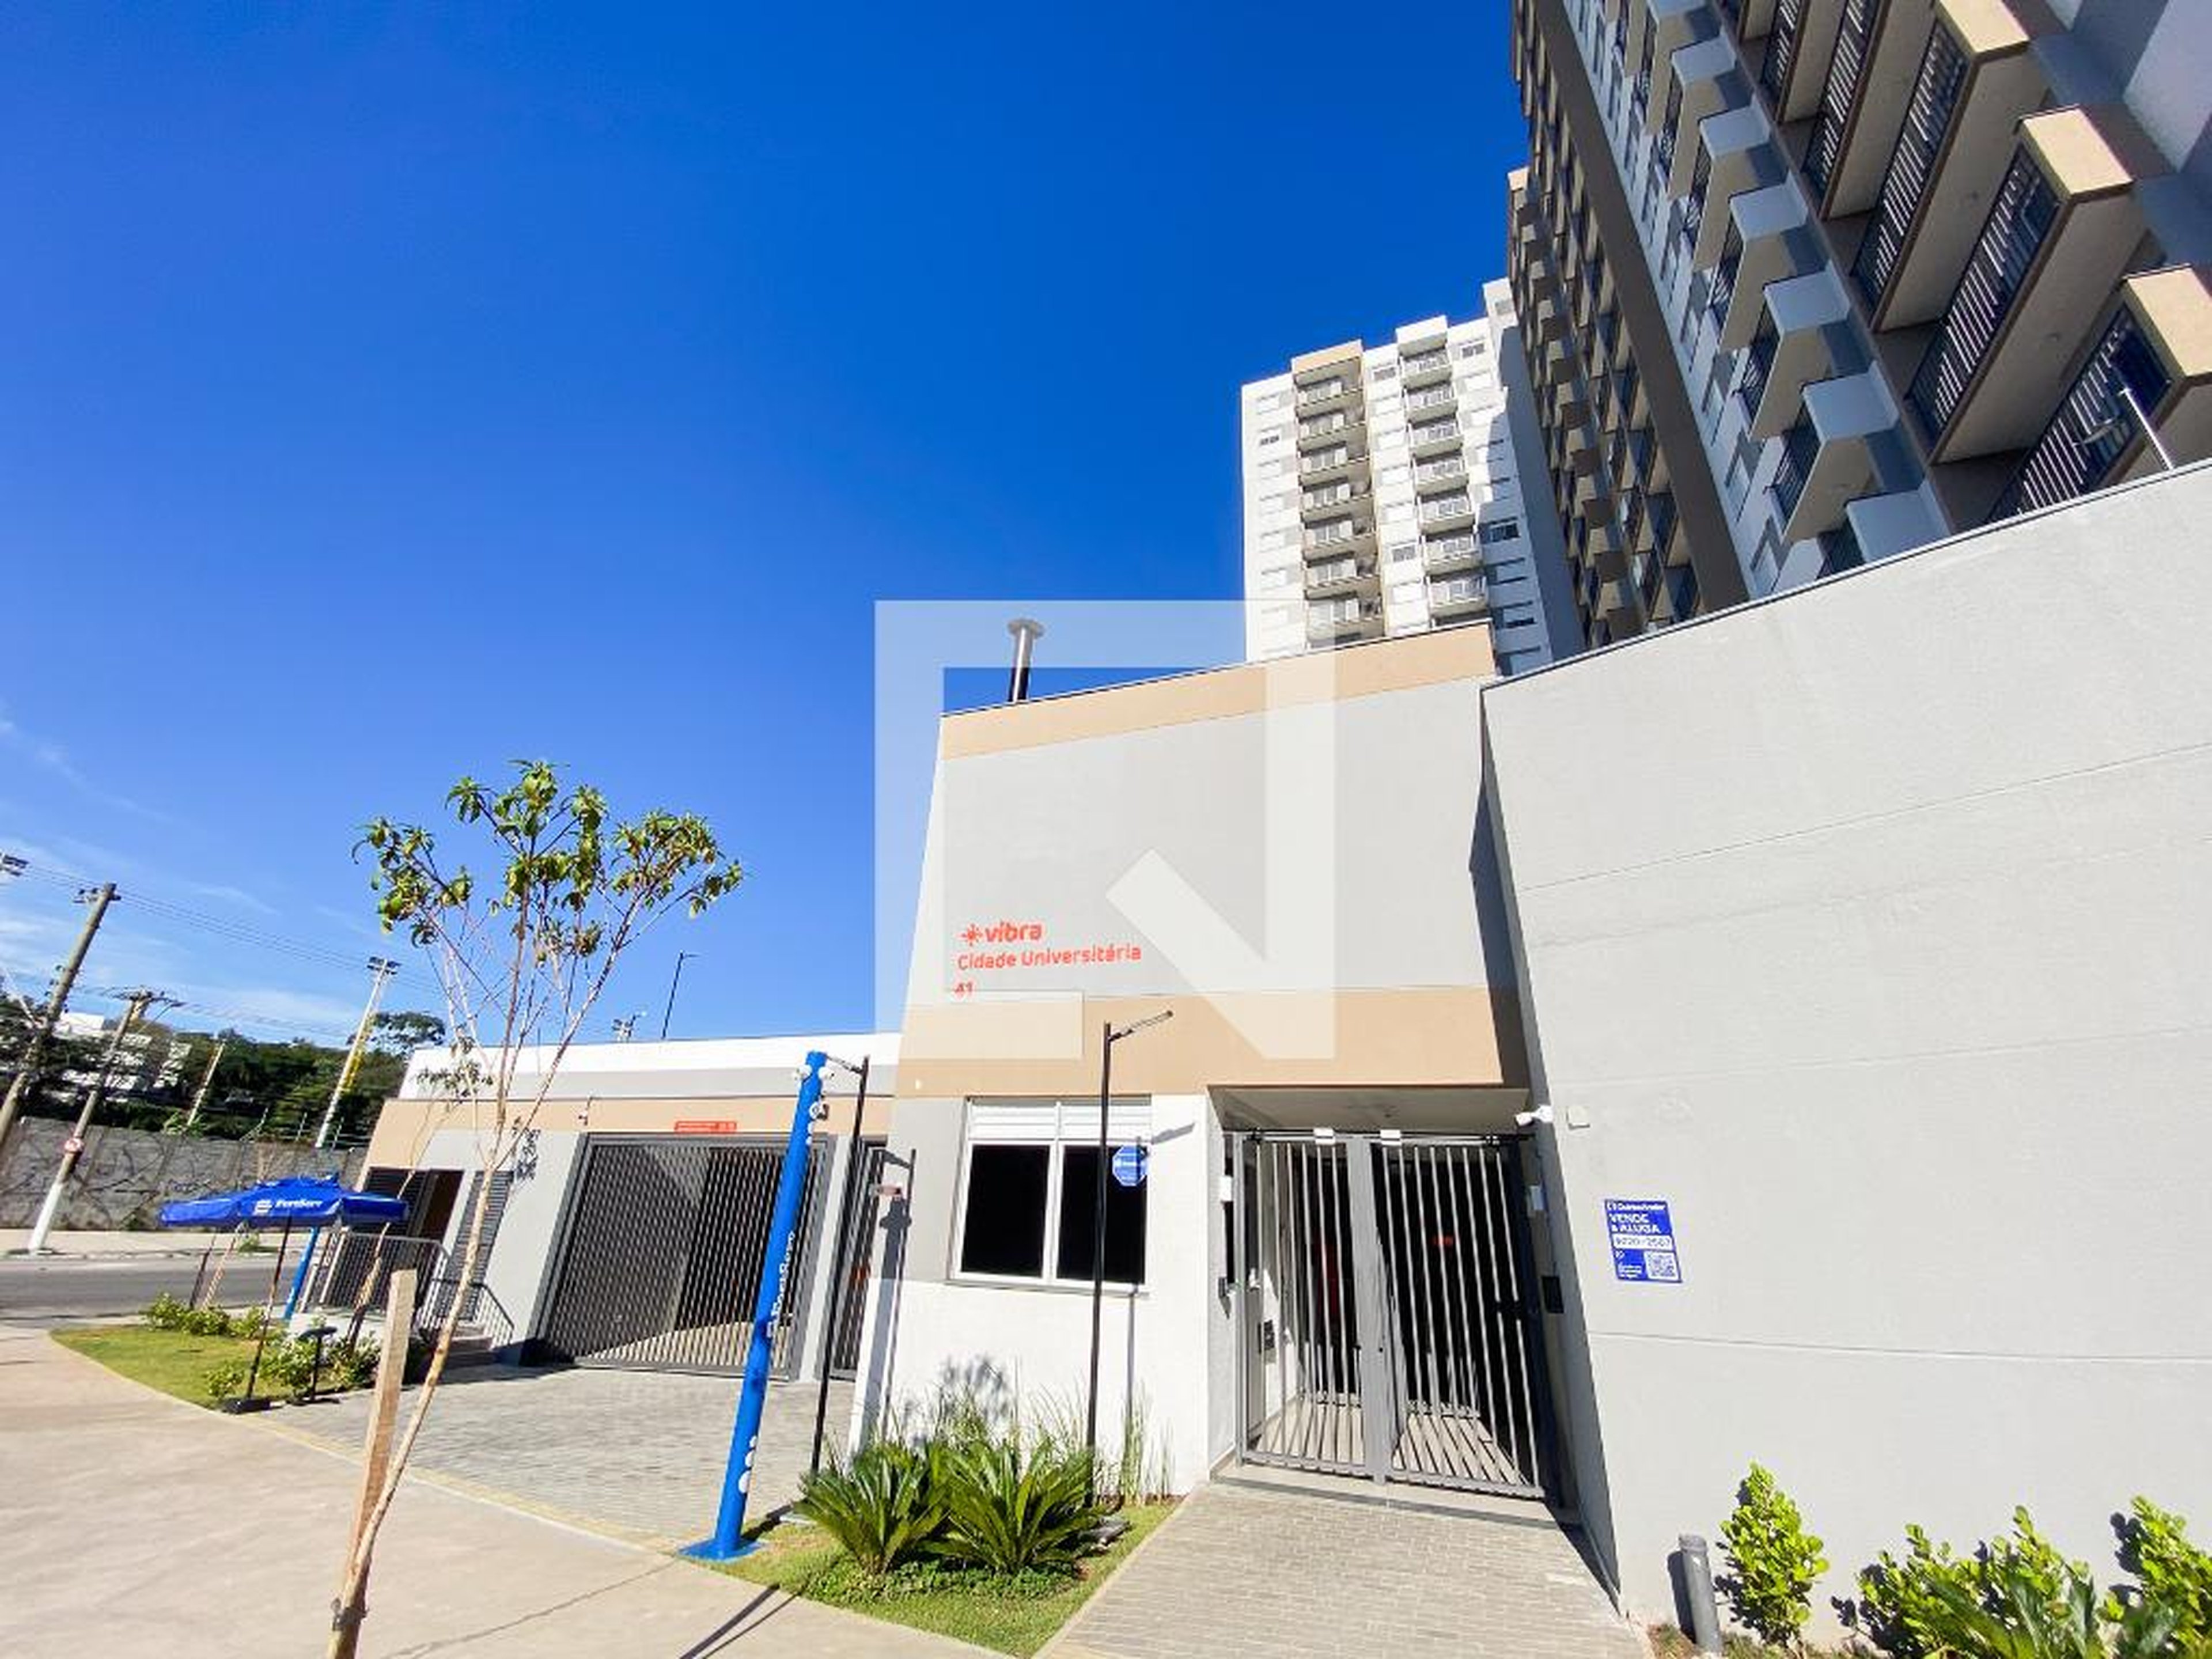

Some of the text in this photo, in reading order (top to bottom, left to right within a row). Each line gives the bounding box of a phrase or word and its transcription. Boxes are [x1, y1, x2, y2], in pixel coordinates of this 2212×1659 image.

[984, 922, 1043, 942] vibra
[958, 945, 1142, 971] Cidade Universitária
[955, 981, 974, 997] 41
